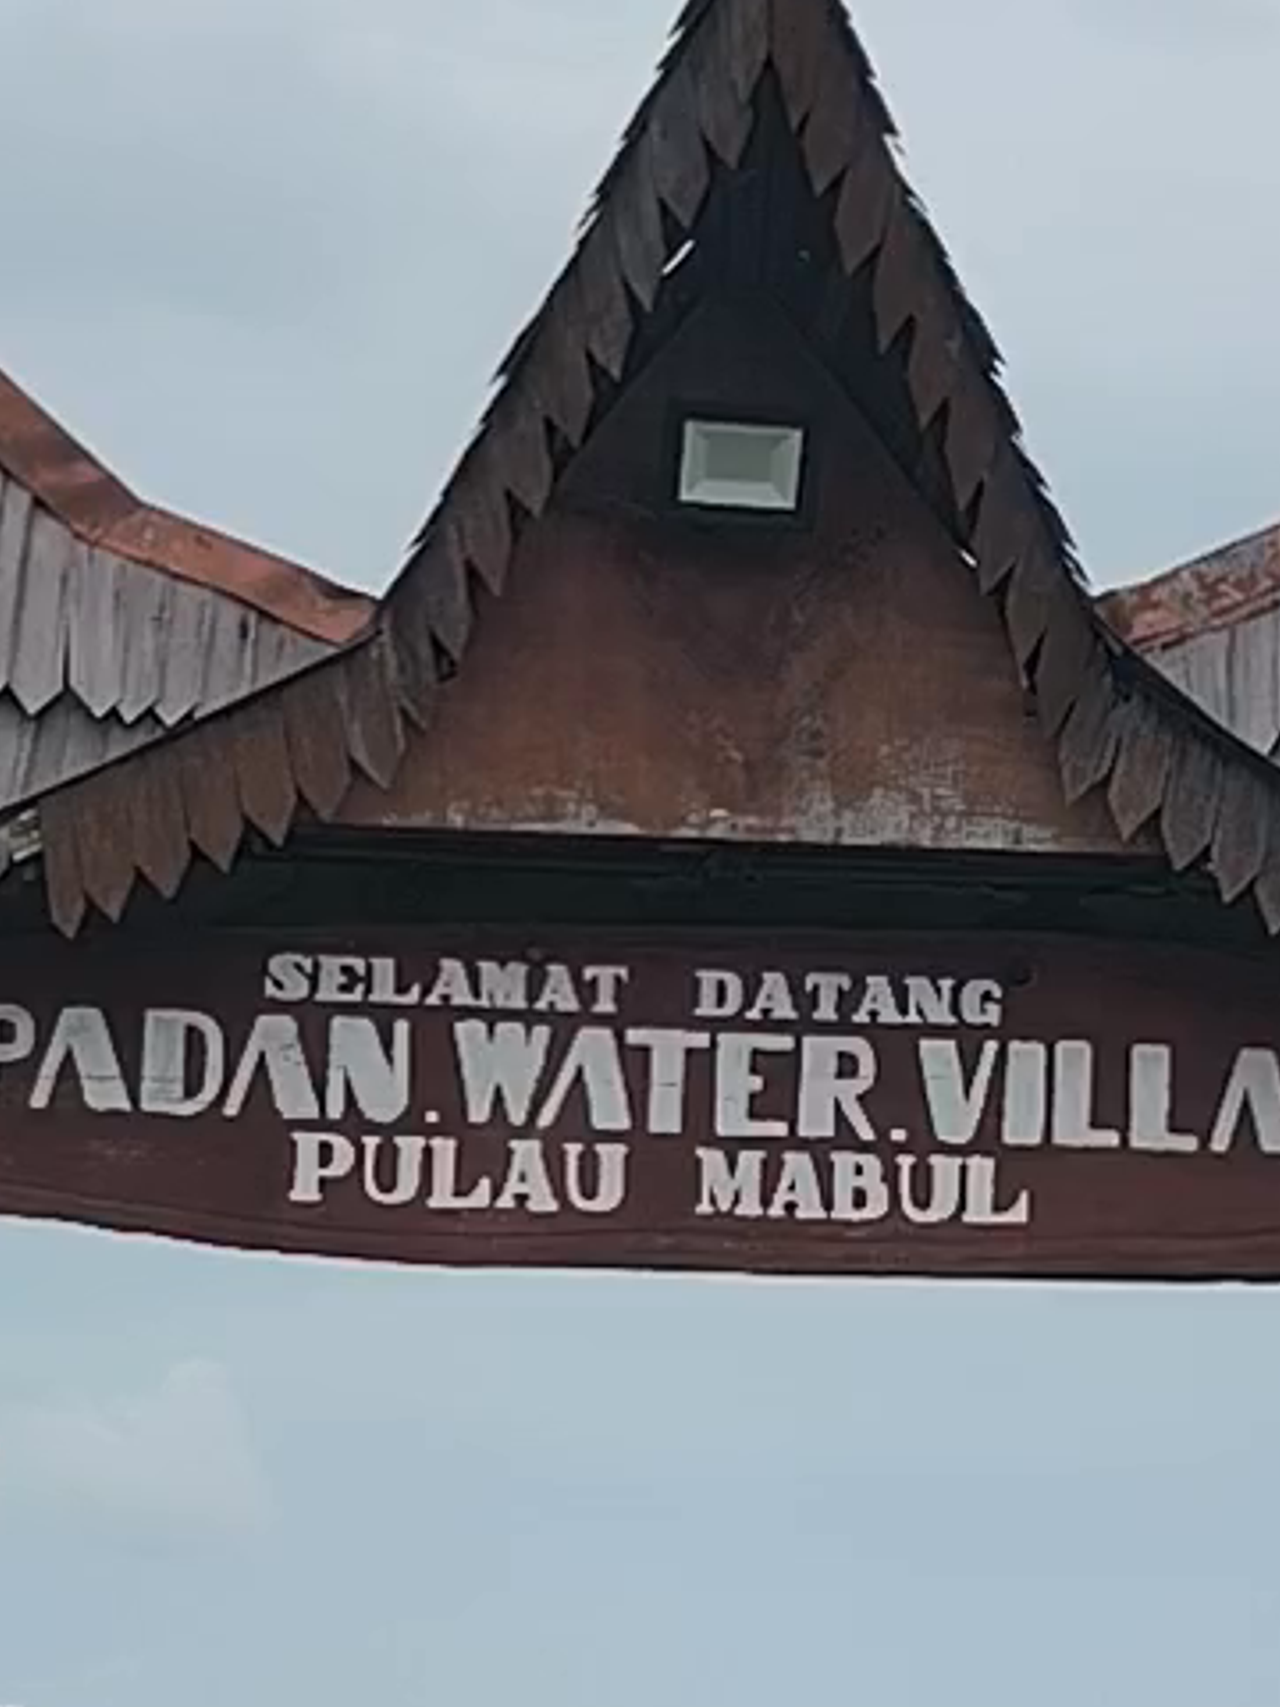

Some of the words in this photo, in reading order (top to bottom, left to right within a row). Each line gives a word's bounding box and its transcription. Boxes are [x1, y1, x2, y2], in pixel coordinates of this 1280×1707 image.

[263, 953, 629, 1013] SELAMAT
[694, 969, 1002, 1025] DATANG
[288, 1132, 629, 1214] PULAU
[694, 1147, 1030, 1225] MABUL
